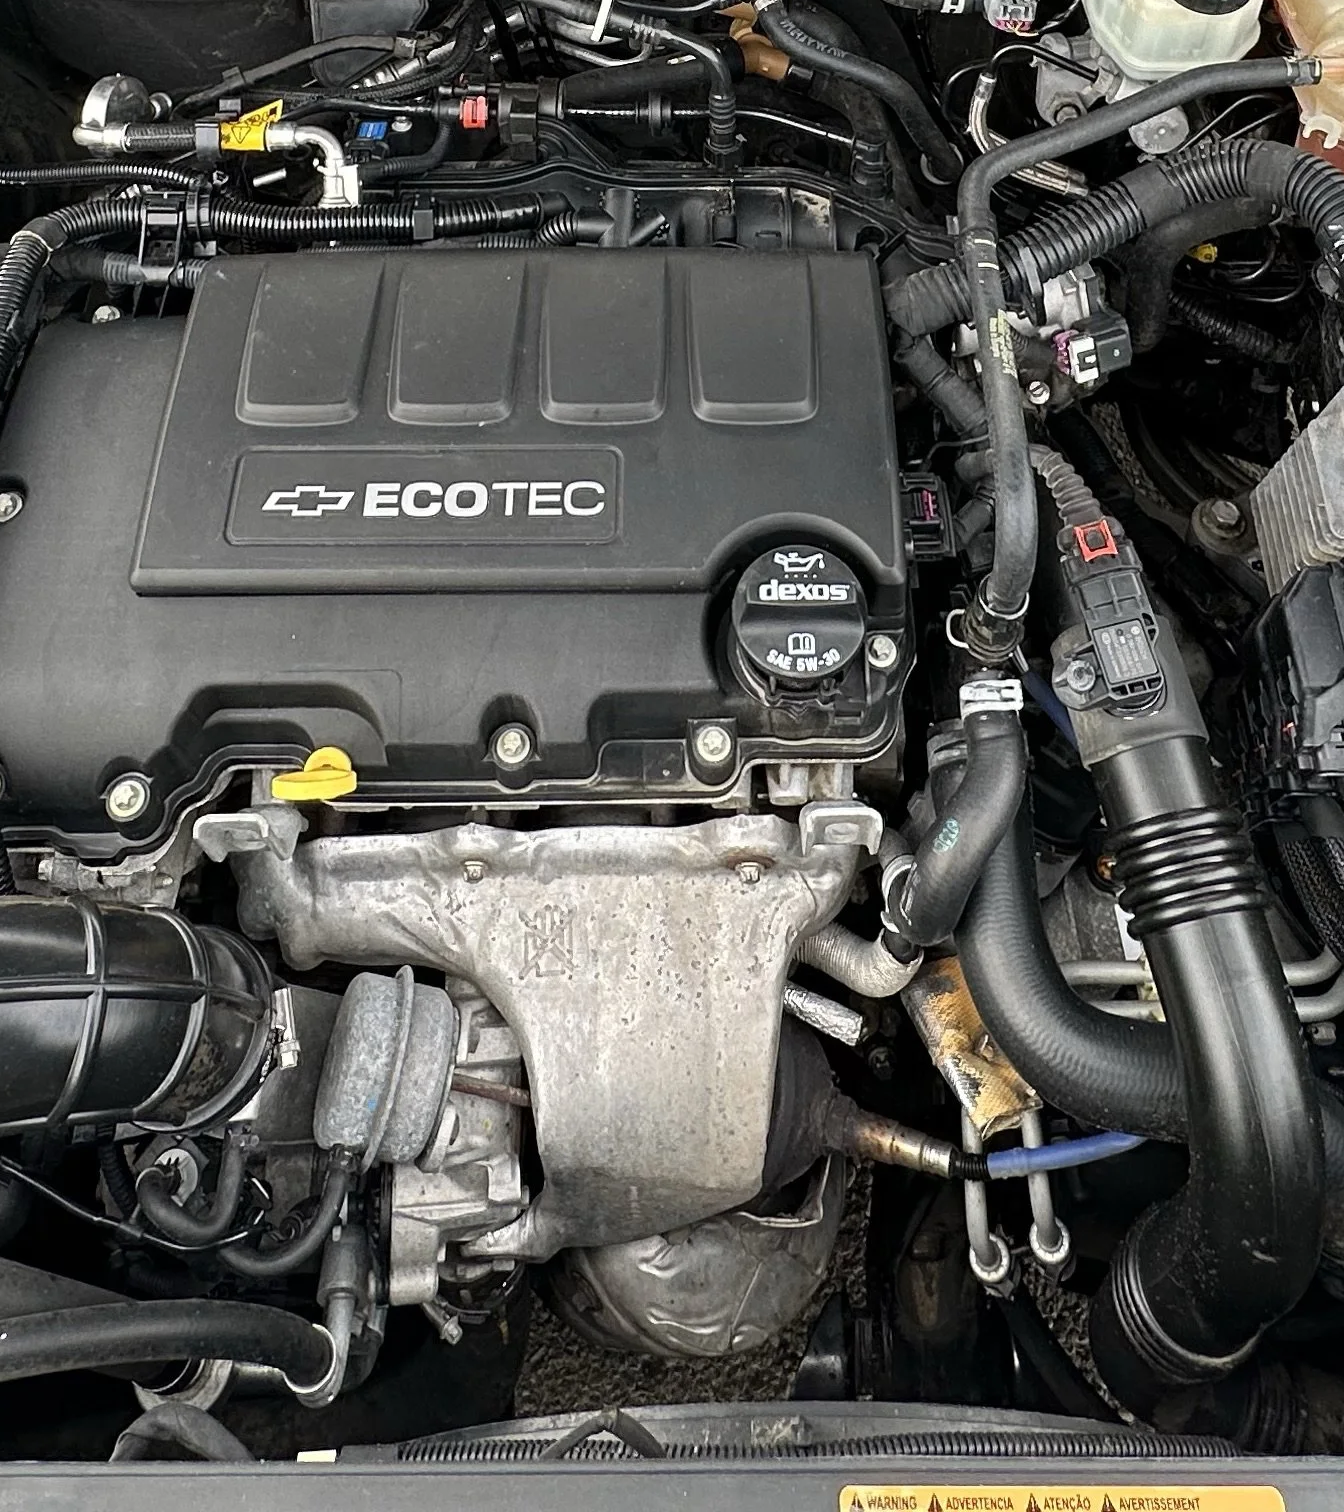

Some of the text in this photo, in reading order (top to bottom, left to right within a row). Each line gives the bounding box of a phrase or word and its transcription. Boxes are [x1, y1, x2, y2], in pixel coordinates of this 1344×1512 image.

[362, 480, 606, 517] ECOTEC
[758, 579, 849, 601] dexos
[766, 648, 840, 672] SAE 5W-30
[867, 1494, 1201, 1512] WARNING ADVERTENCIA ATENÇÃO AVERTISSEMENT
